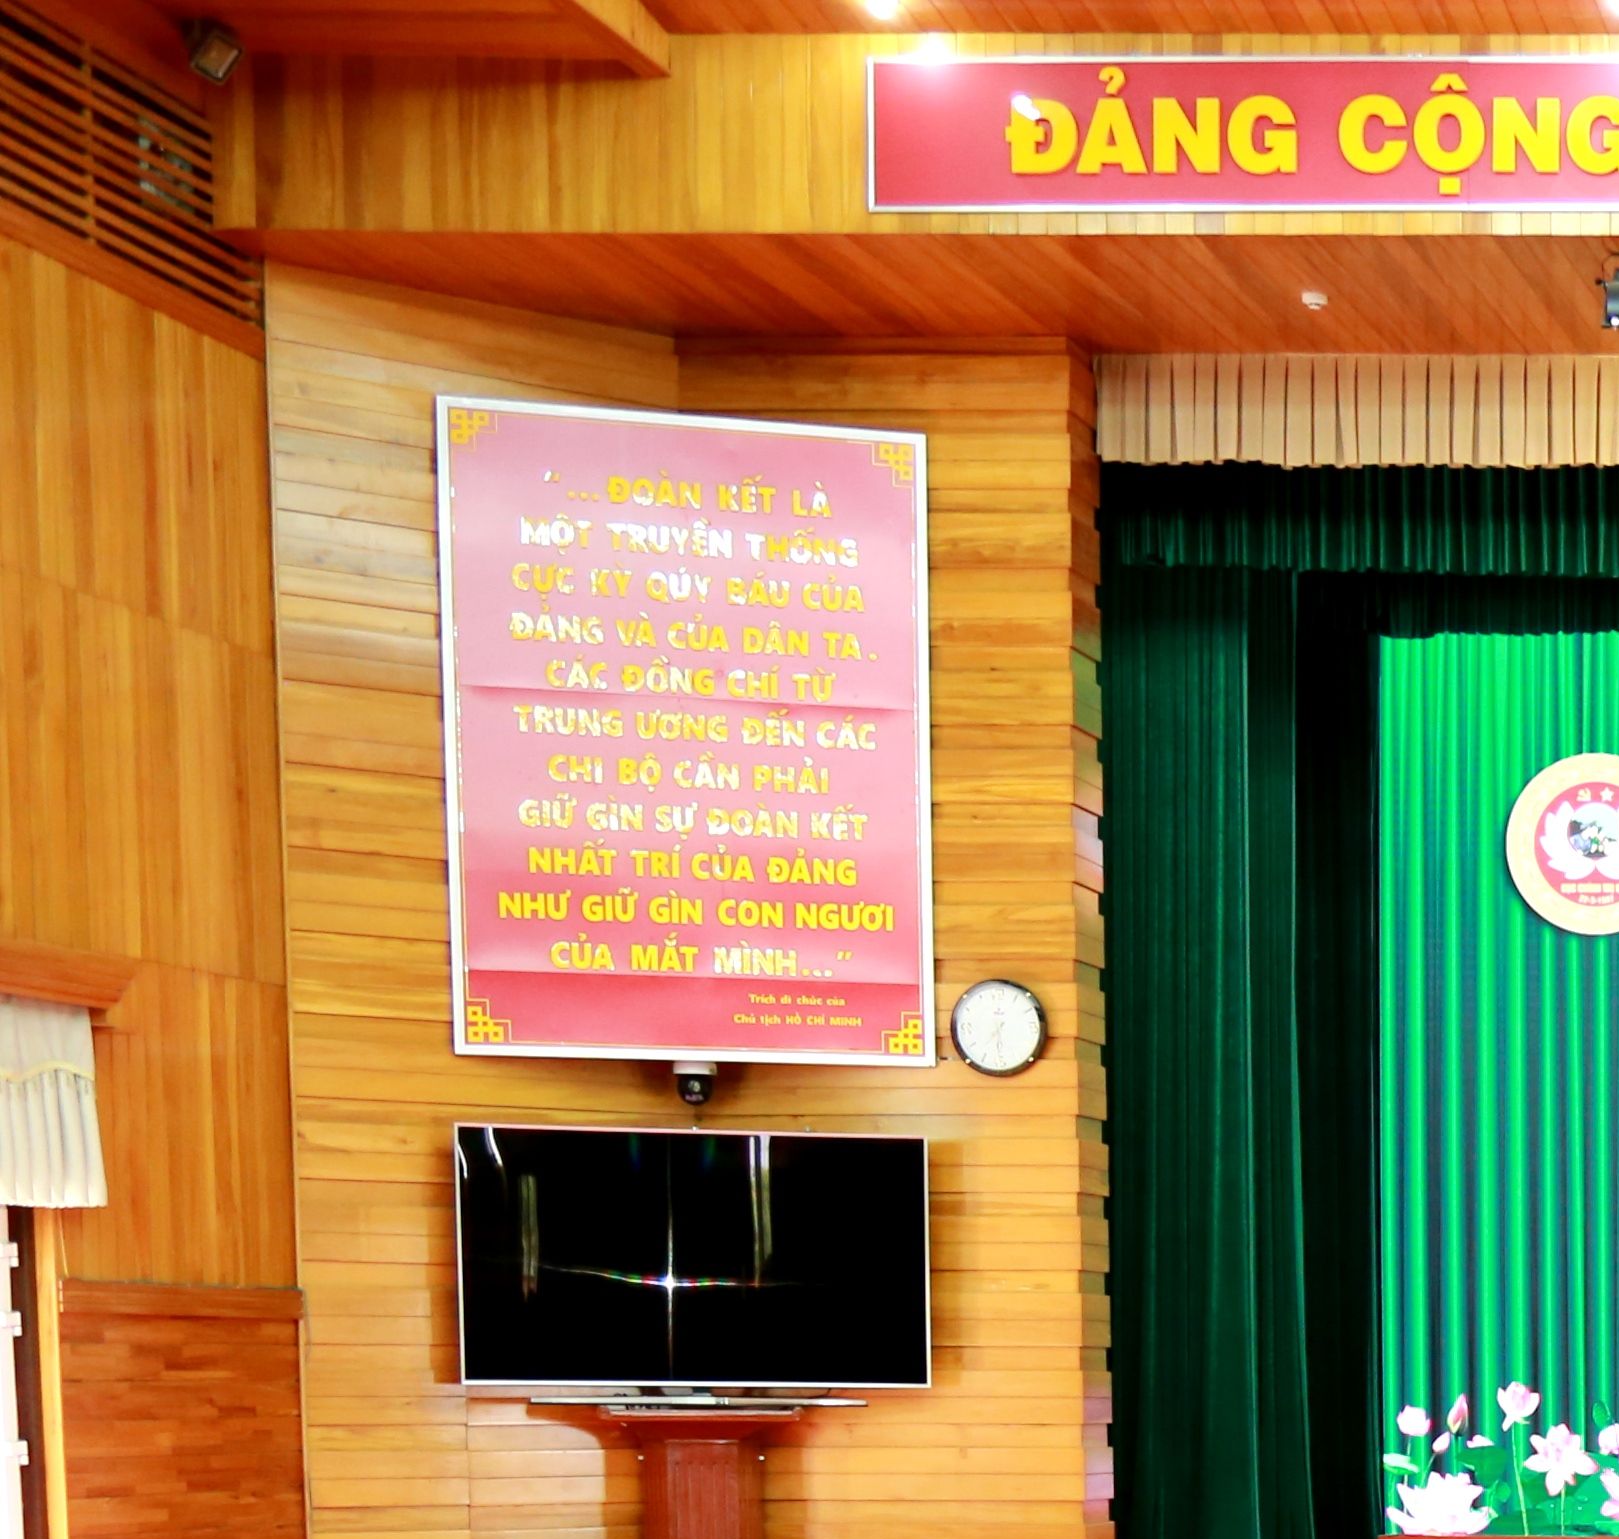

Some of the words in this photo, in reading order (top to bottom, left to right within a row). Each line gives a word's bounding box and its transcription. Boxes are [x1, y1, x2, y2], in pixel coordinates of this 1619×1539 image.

[1005, 67, 1297, 174] ĐẢNG
[718, 475, 776, 513] KẾT
[792, 481, 832, 518] LÀ
[520, 512, 591, 555] MỘT
[511, 563, 575, 600] CỰC
[590, 563, 632, 597] KỲ
[726, 572, 790, 607] BÁU
[803, 574, 865, 612] CỦA
[510, 605, 604, 645] ĐẢNG
[616, 612, 657, 647] VÀ
[667, 613, 729, 653] CỦA
[743, 621, 810, 657] DÂN
[546, 654, 608, 690] CÁC
[622, 656, 714, 696] ĐỒNG
[727, 666, 779, 699] CHÍ
[793, 670, 837, 702] TỪ
[514, 705, 623, 739] TRUNG
[636, 709, 728, 745] ƯƠNG
[741, 711, 805, 747] ĐẾN
[817, 715, 878, 750] CÁC
[548, 755, 602, 783] CHI
[618, 753, 662, 792] BỘ
[673, 751, 739, 790] CẦN
[753, 758, 828, 794] PHẢI
[518, 795, 578, 829] GIỮ
[586, 795, 643, 832] GÌN
[655, 802, 696, 841] SỰ
[706, 803, 798, 839] ĐOÀN
[811, 803, 868, 841] KẾT
[528, 838, 617, 877] NHẤT
[630, 845, 680, 878] TRÍ
[691, 844, 755, 883] CỦA
[767, 849, 857, 887] ĐẢNG
[498, 889, 571, 920] NHƯ
[582, 887, 638, 923] GIỮ
[649, 890, 702, 925] GÌN
[718, 899, 783, 929] CON
[796, 901, 895, 932] NGƯƠI
[550, 932, 615, 971] CỦA
[630, 932, 699, 973] MẮT
